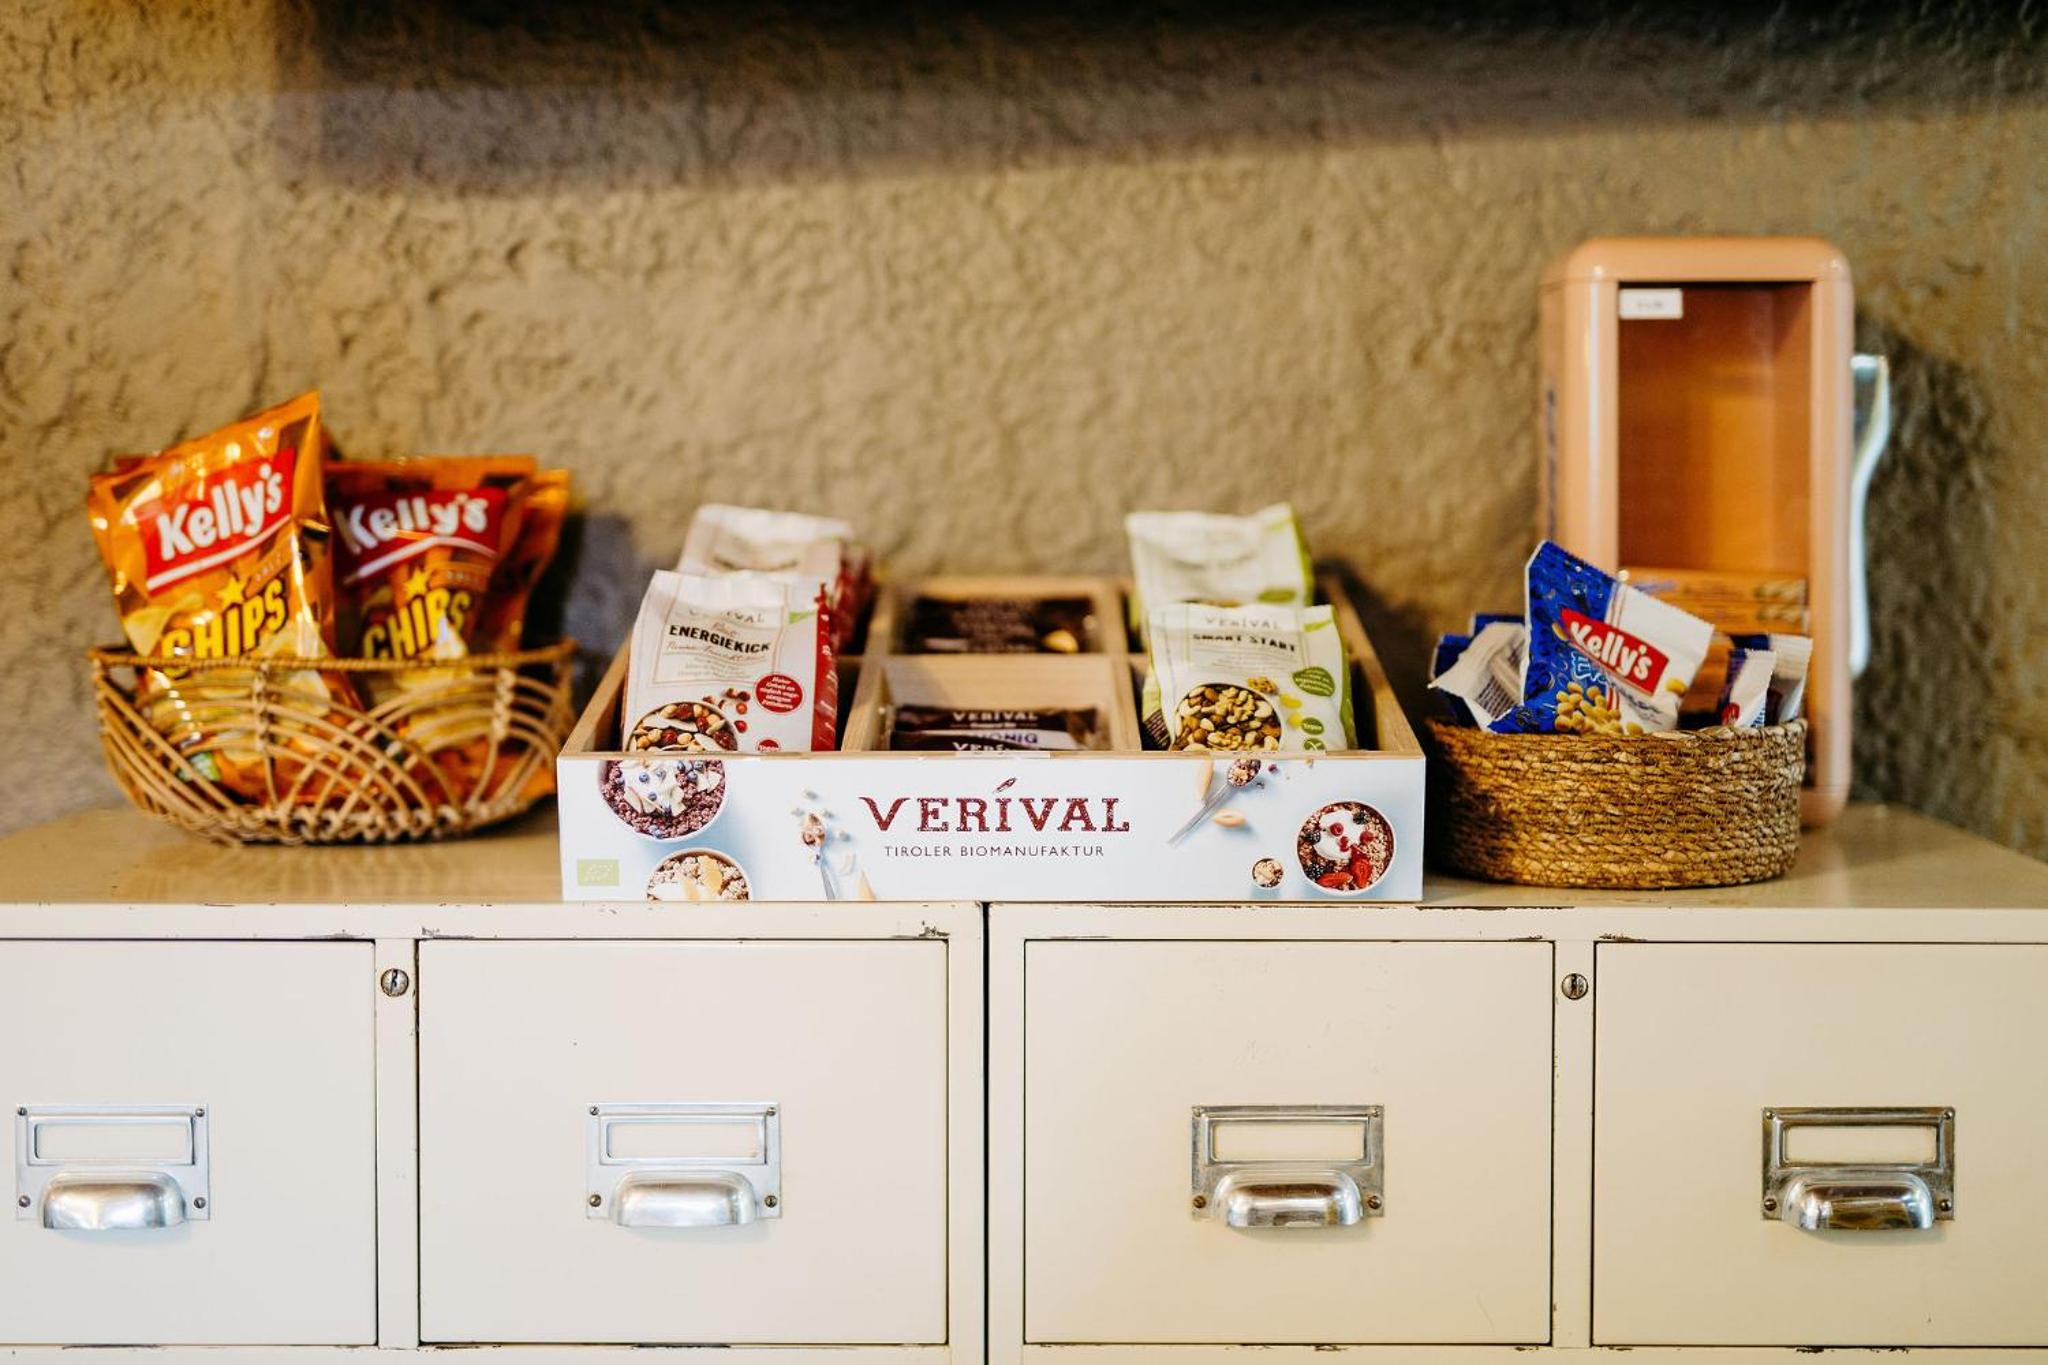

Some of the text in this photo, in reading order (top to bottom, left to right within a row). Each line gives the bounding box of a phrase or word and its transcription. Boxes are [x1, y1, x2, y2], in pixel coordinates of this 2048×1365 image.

[155, 464, 283, 562] Kelly's
[333, 493, 489, 555] Kelly's
[161, 576, 289, 678] CHIPS
[363, 588, 472, 662] CHIPS
[669, 624, 771, 654] ENERGIEKICK
[1570, 620, 1653, 681] Kelly's
[885, 845, 1105, 858] TIROLER BIOMANUFAKTUR
